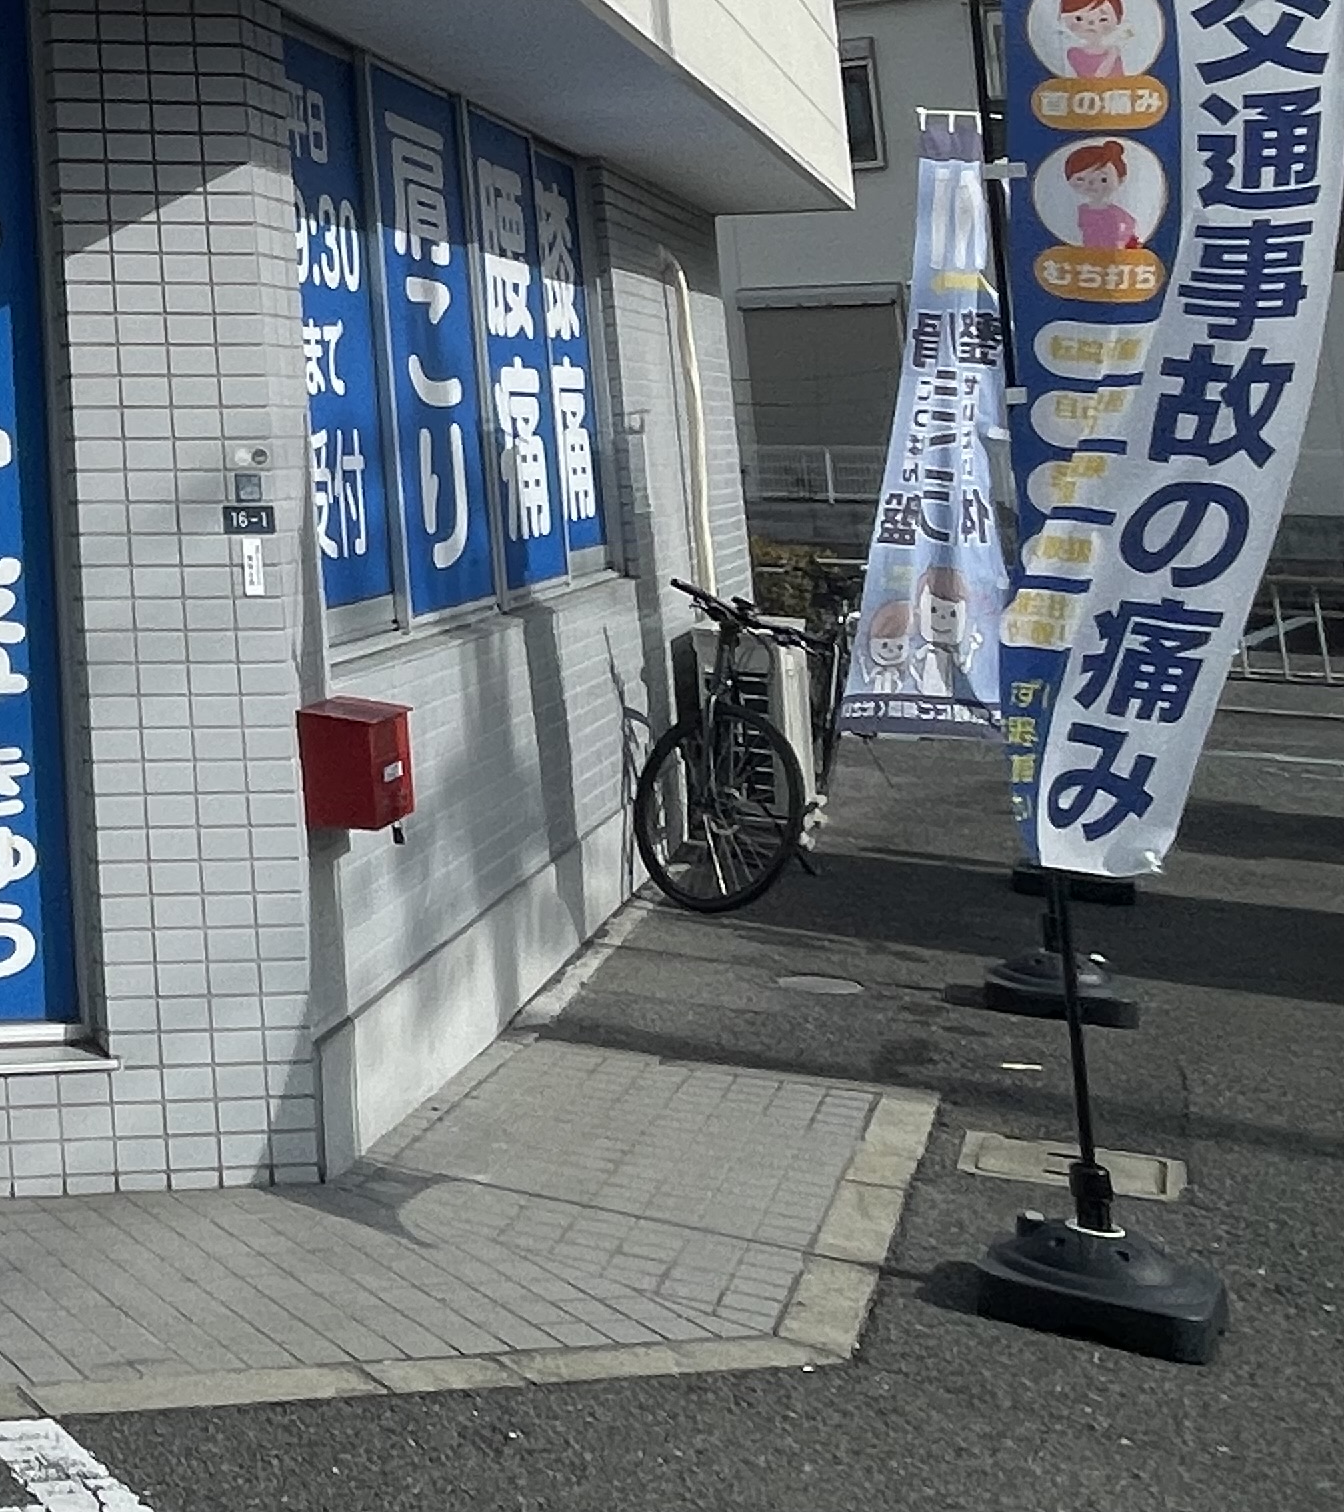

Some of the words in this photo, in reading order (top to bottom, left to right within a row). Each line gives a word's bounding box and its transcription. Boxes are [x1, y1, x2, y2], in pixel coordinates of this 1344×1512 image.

[384, 109, 469, 570] 肩こり
[231, 511, 268, 528] 16-1
